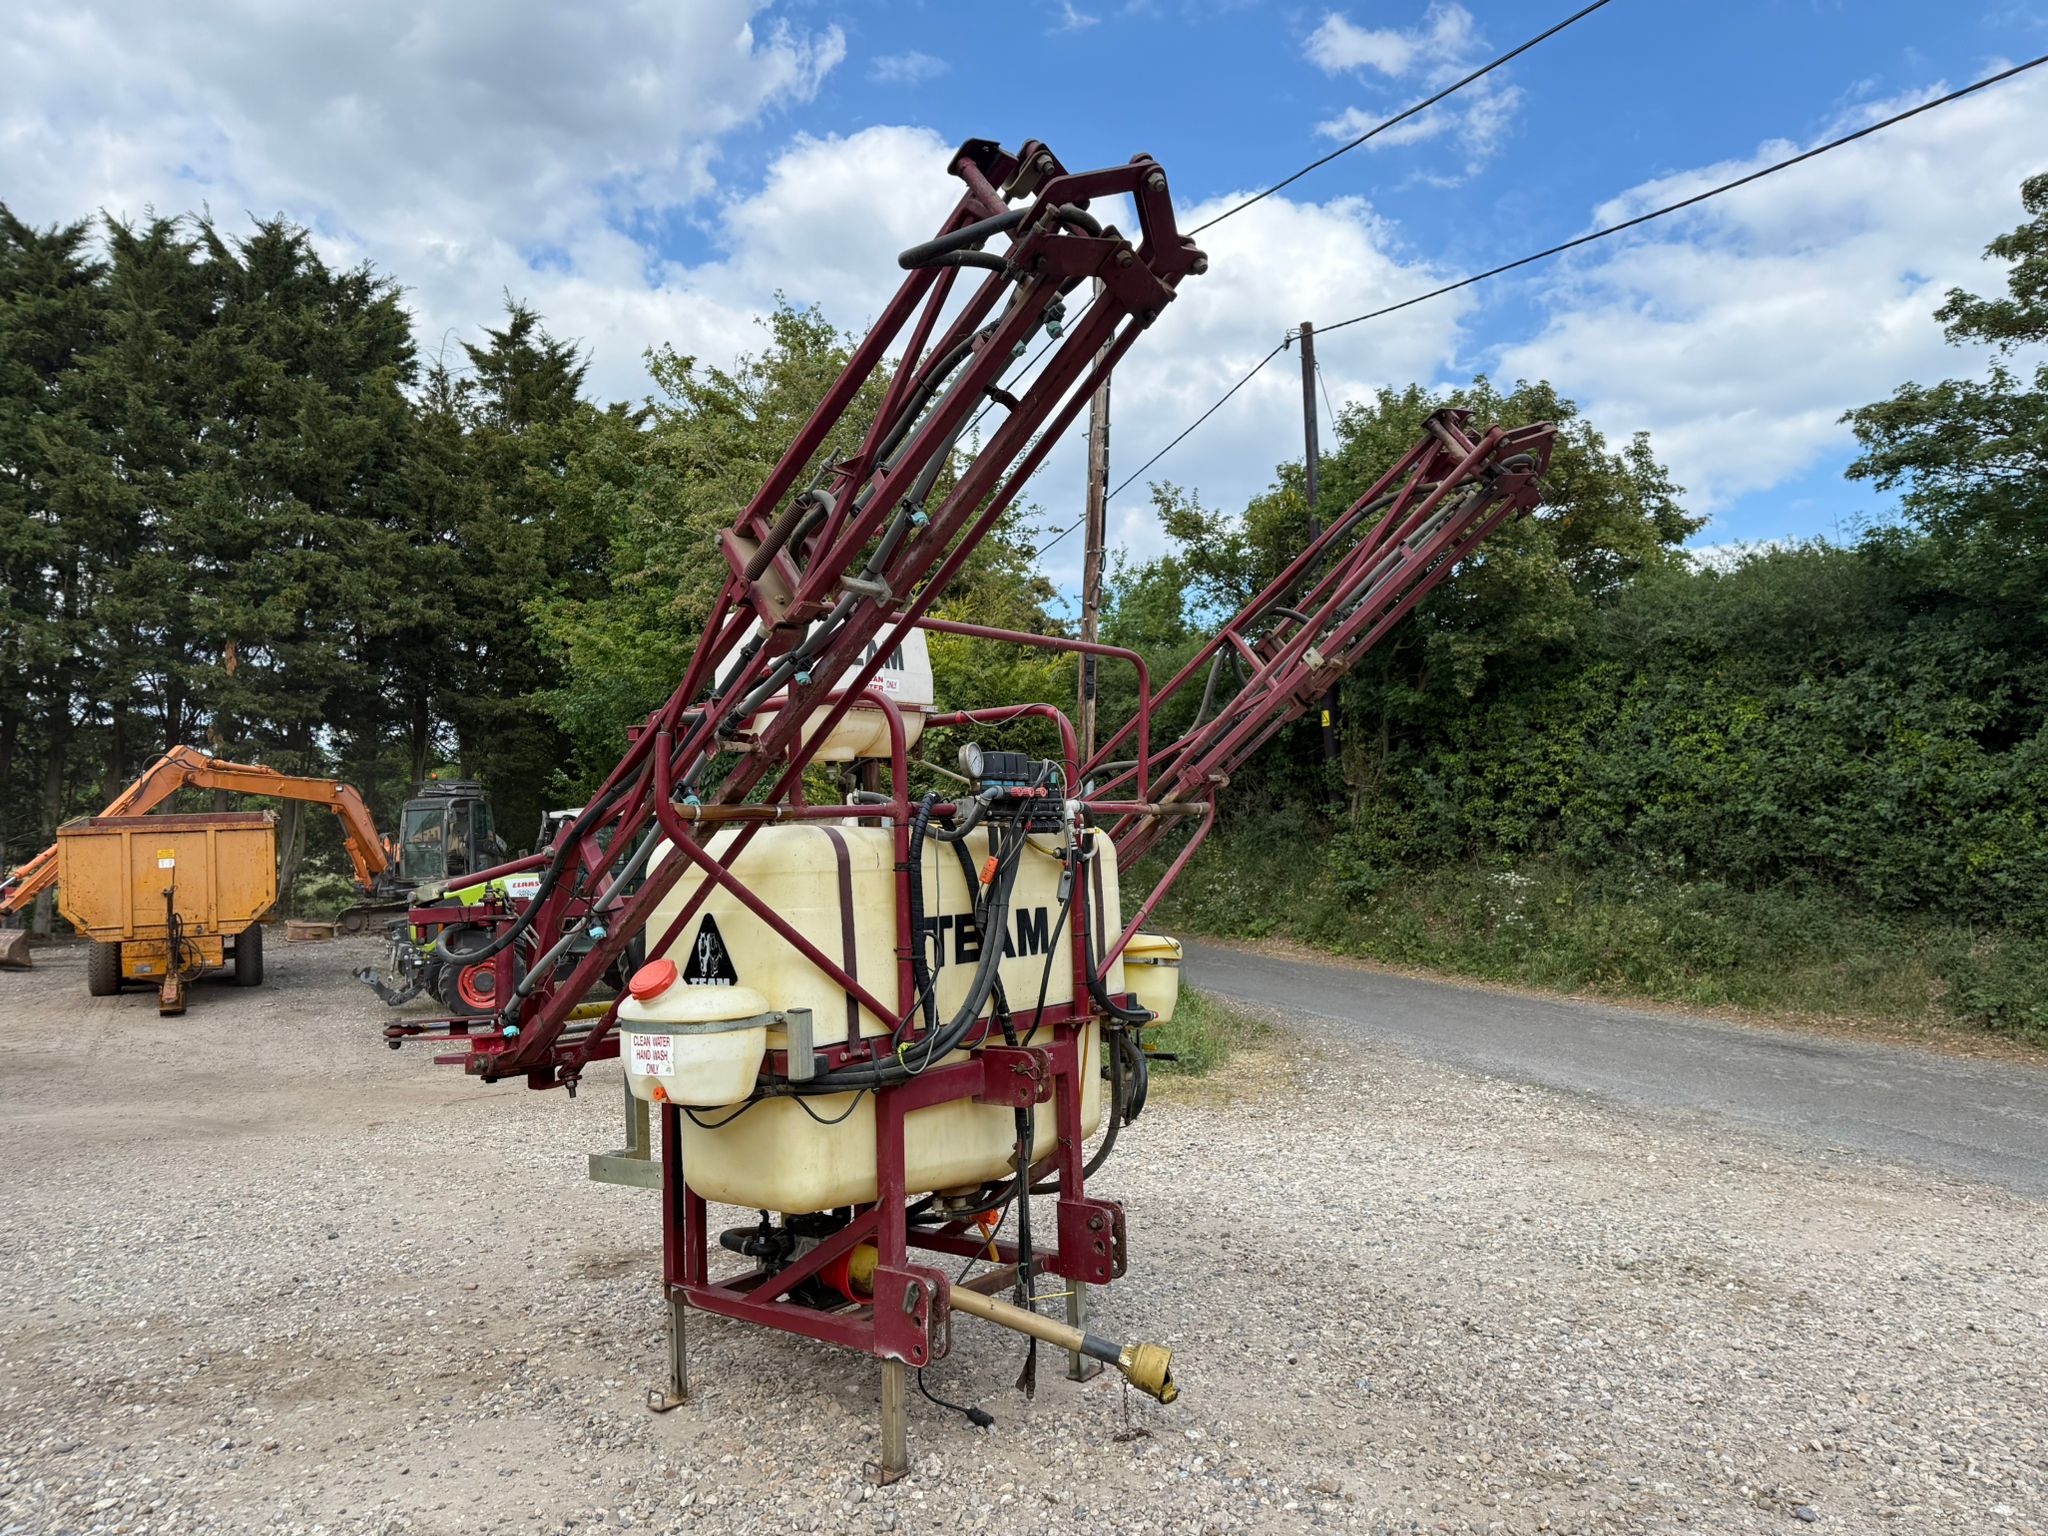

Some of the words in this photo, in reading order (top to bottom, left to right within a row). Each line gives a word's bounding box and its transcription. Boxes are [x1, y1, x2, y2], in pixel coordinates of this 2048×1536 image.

[690, 977, 730, 987] TEAM
[633, 1036, 651, 1046] CLEAN
[652, 1036, 671, 1047] WATER
[636, 1050, 651, 1060] HAND
[652, 1050, 668, 1061] WASH
[646, 1063, 659, 1074] ONLY
